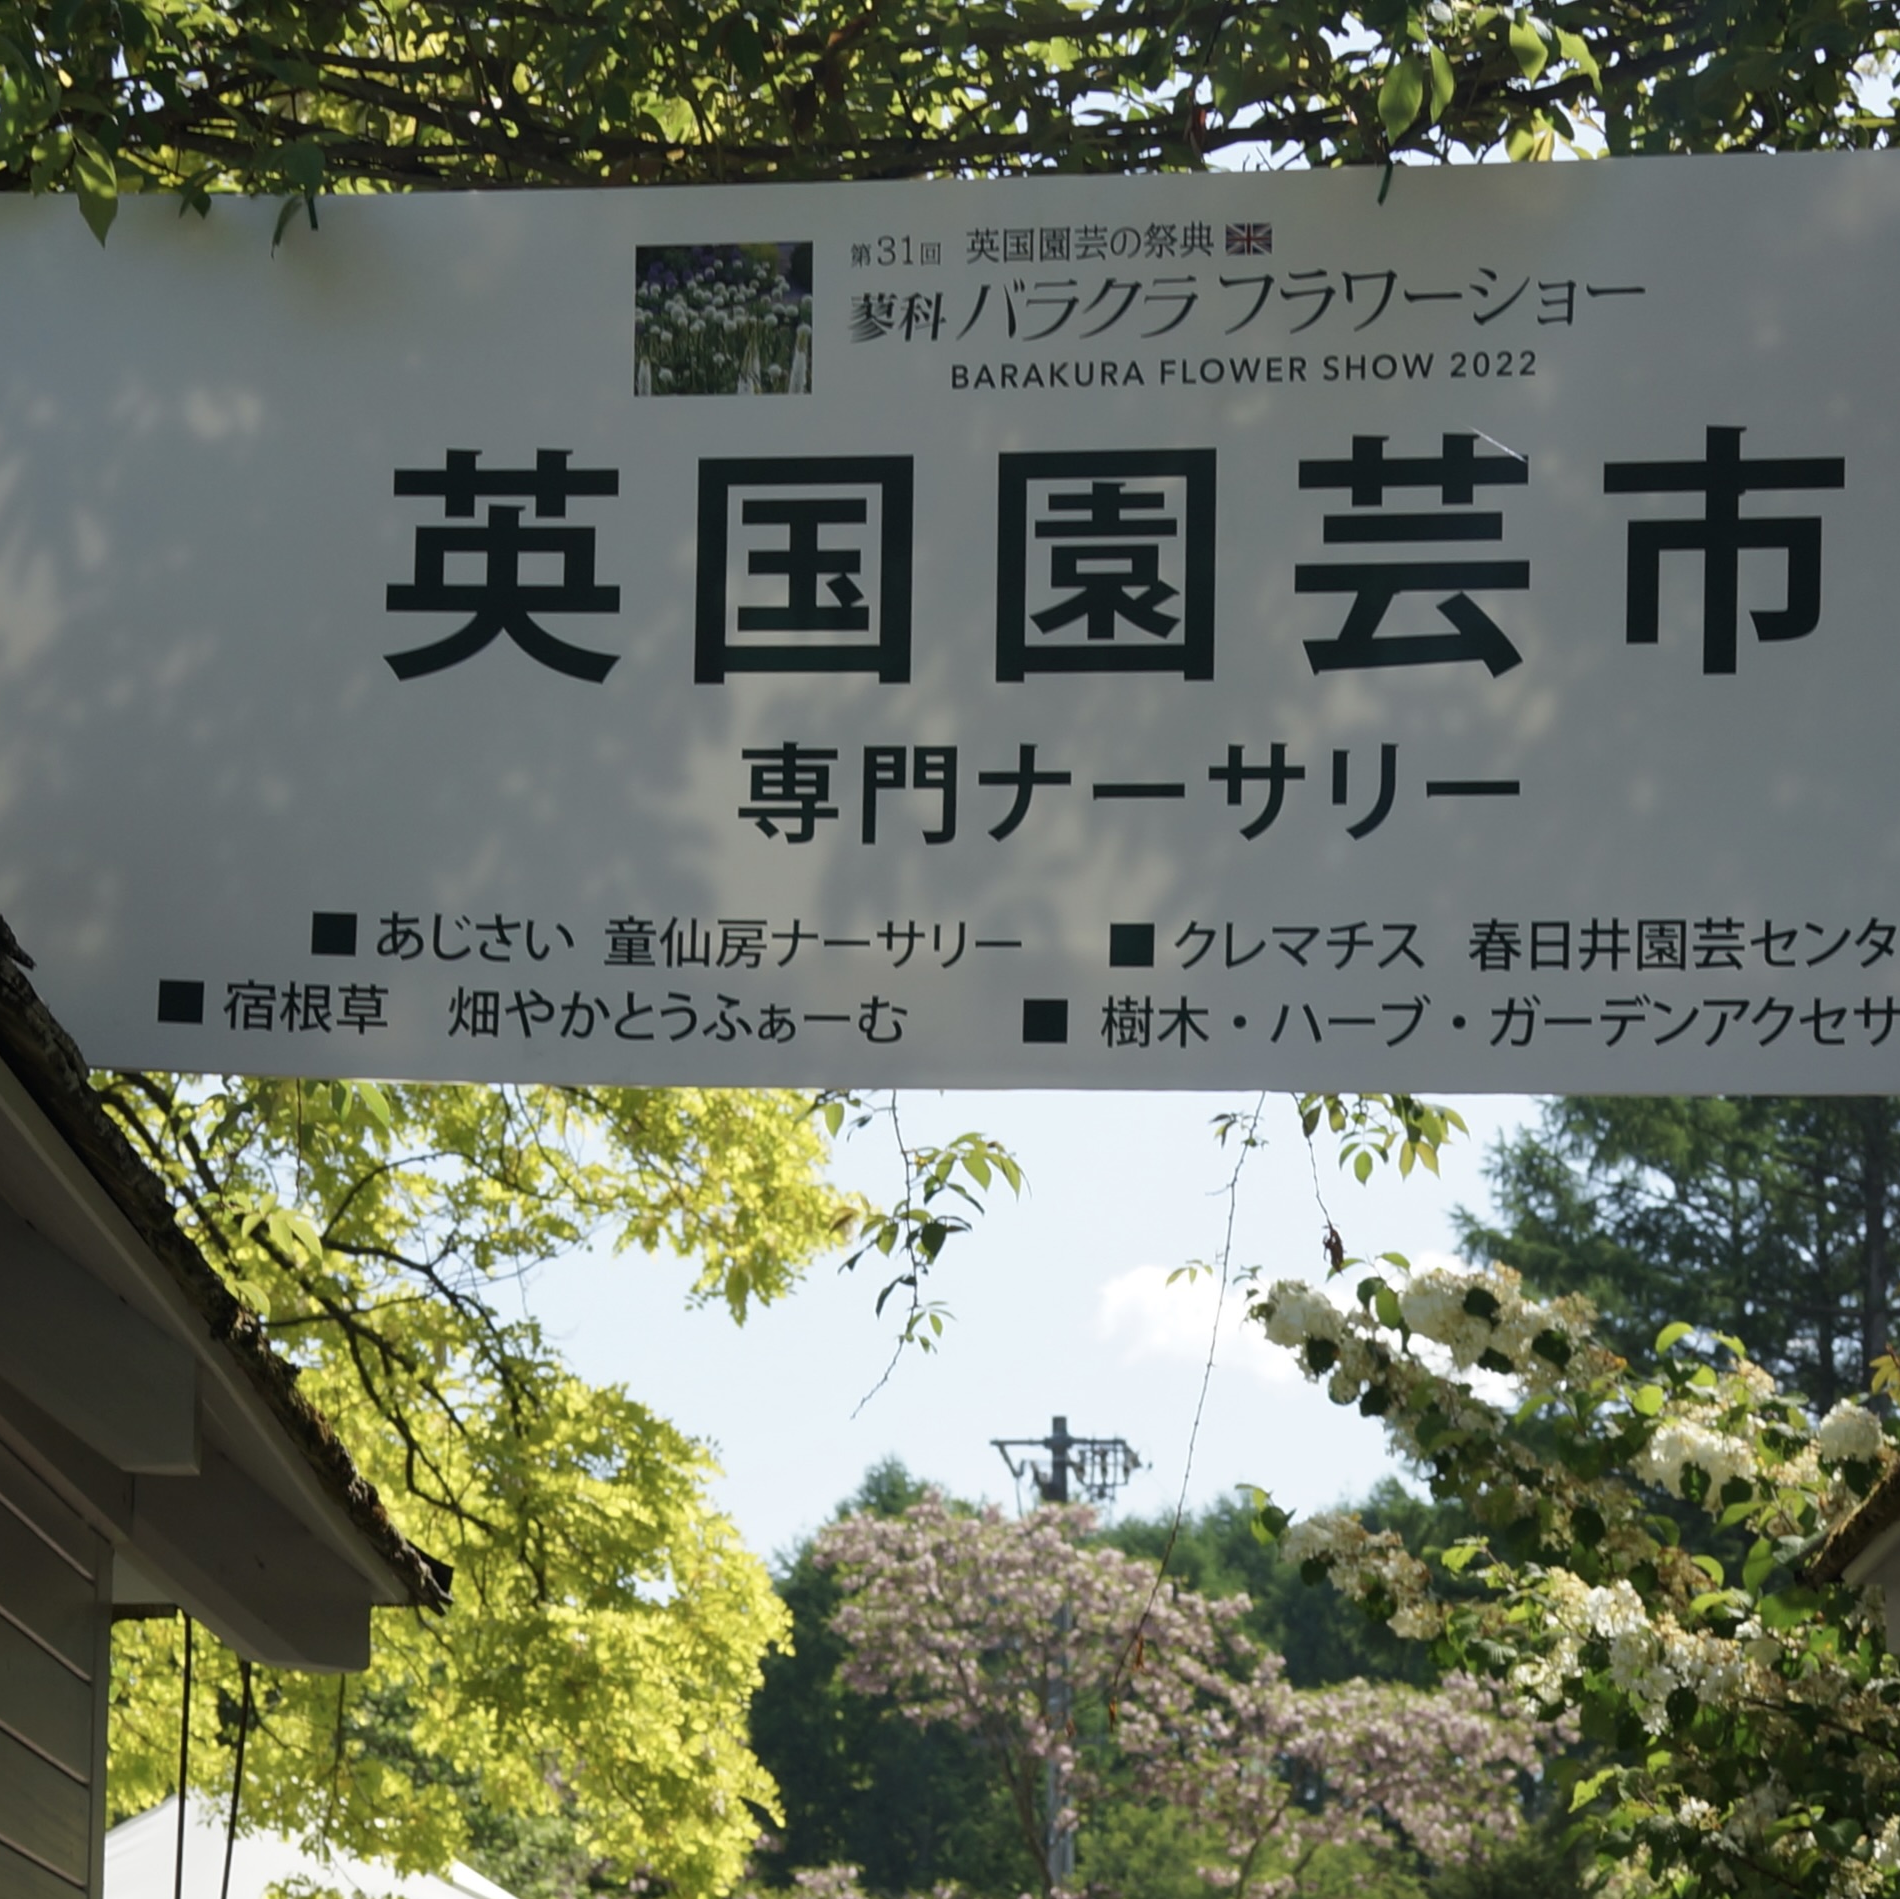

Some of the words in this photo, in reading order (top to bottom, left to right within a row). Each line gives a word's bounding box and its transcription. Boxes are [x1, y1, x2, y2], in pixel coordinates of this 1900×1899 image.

[851, 235, 942, 267] 第31回
[966, 220, 1215, 265] 英国園芸の祭典
[851, 291, 947, 343] 蓼科
[956, 274, 1199, 341] バラクラ
[1218, 267, 1646, 335] フラワーショー
[951, 360, 1145, 390] BARAKURA
[1160, 356, 1307, 386] FLOWER
[1322, 352, 1435, 382] SHOW
[1450, 349, 1536, 379] 2022
[382, 424, 1846, 686] 英国園芸市
[737, 740, 1521, 846] 専門ナーサリー
[376, 910, 575, 963] あじさい
[603, 914, 1023, 969] 童仙房ナーサリー
[1174, 920, 1426, 971] クレマチス
[222, 978, 389, 1036] 宿根草
[447, 985, 908, 1045] 畑やかとうふぁーむ
